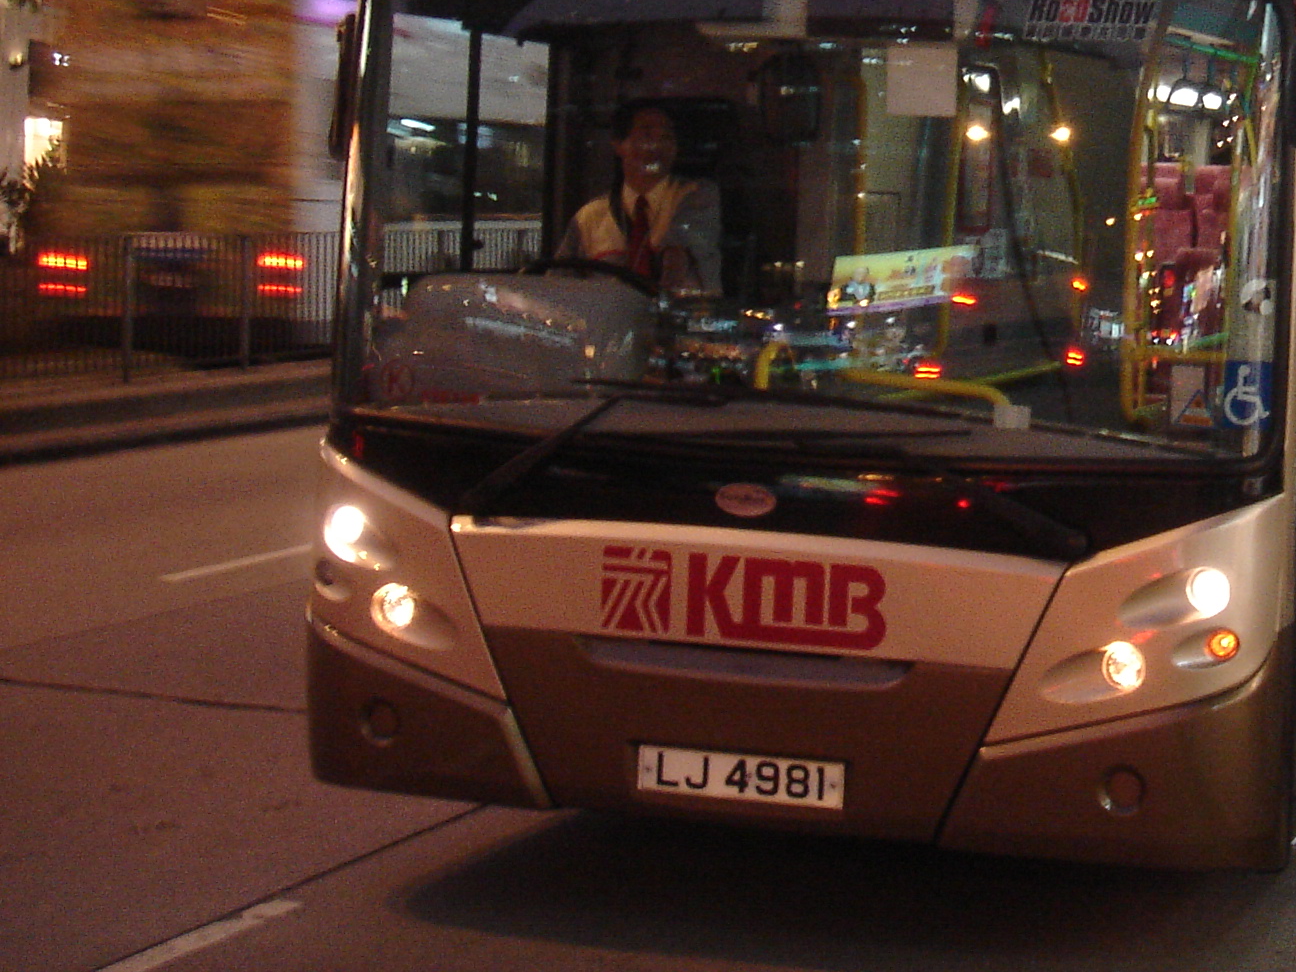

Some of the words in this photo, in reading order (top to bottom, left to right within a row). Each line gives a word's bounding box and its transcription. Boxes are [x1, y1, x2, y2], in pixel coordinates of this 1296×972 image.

[685, 551, 887, 651] KMB
[655, 750, 710, 790] LJ
[725, 758, 825, 801] 4981
